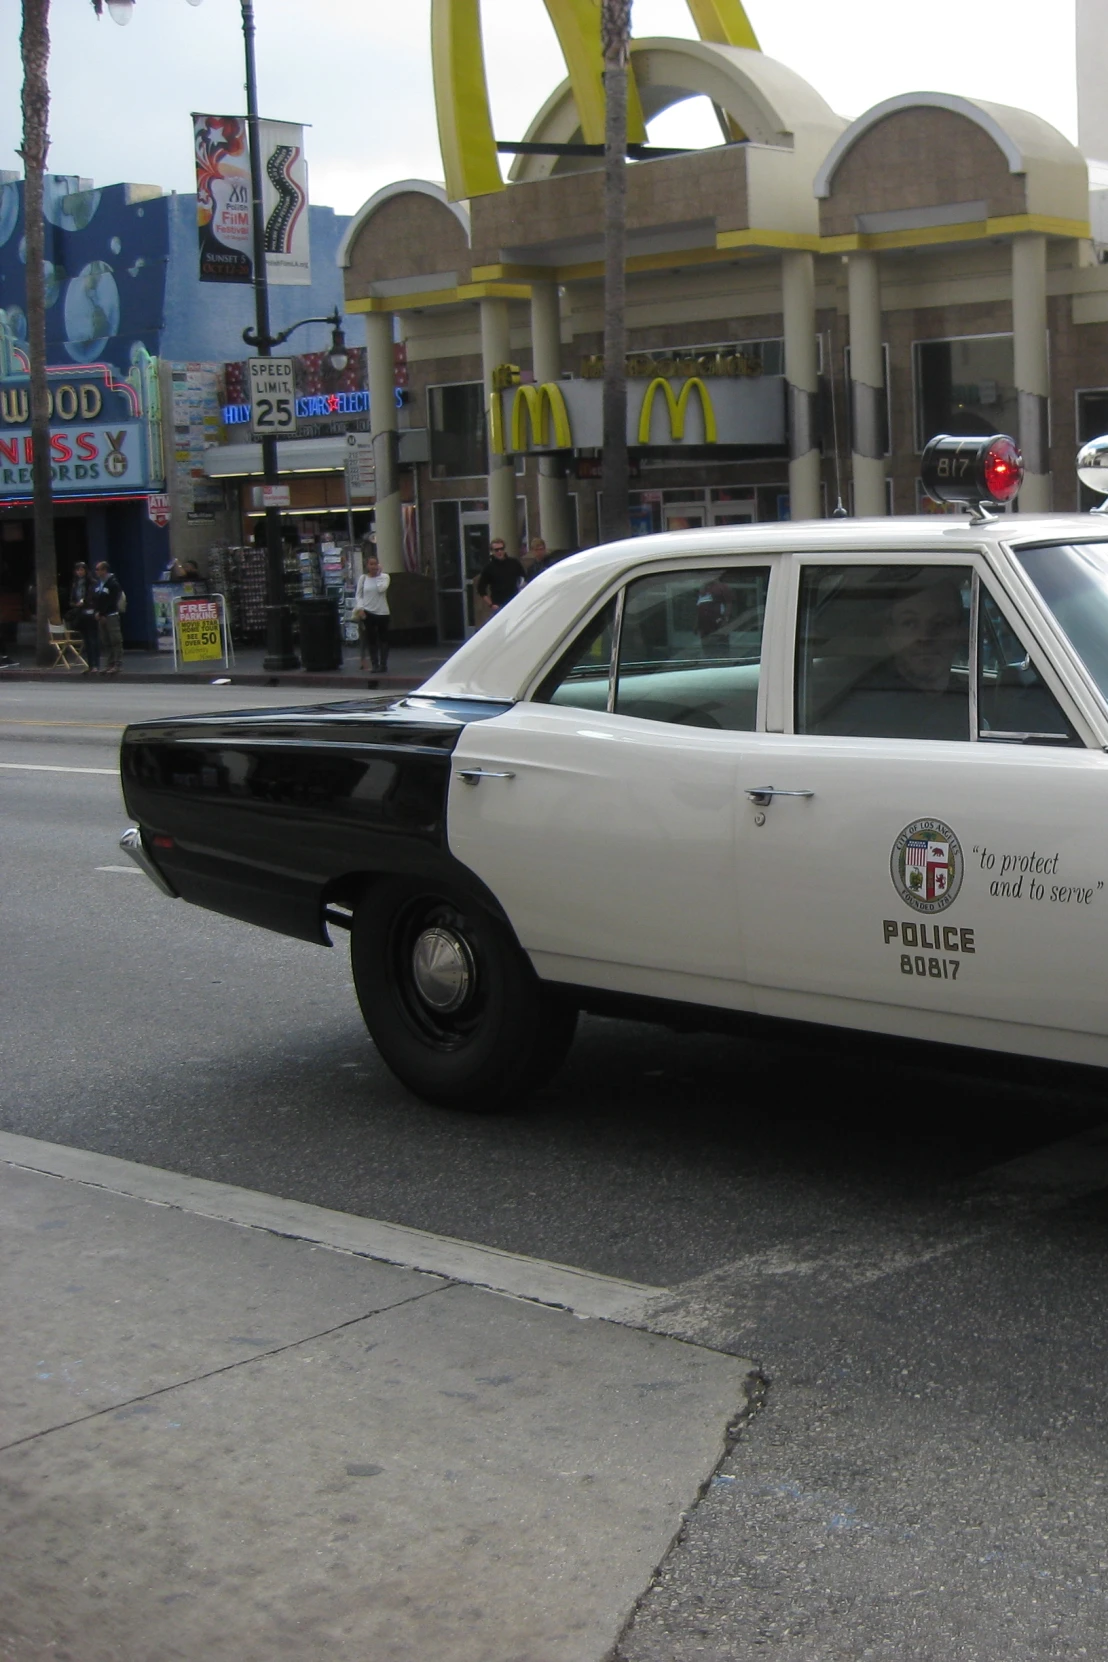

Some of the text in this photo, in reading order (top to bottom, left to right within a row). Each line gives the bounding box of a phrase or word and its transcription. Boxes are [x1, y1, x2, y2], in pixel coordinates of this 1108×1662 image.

[206, 252, 246, 264] SUNSET 5
[252, 364, 292, 376] SPEED
[256, 381, 290, 394] LIMIT
[2, 384, 102, 423] WOD
[256, 399, 293, 427] 25
[937, 457, 969, 478] 817
[150, 495, 170, 507] ATM
[180, 602, 217, 614] FREE
[180, 611, 218, 621] PARKING
[201, 632, 217, 645] 50
[896, 821, 961, 857] CITY OF LOS ANGELES
[1000, 851, 1060, 877] protect
[989, 875, 1024, 899] and
[1029, 878, 1045, 901] to
[901, 889, 953, 911] FOUNDED 1781
[882, 919, 976, 954] POLICE
[900, 953, 960, 981] 80817
